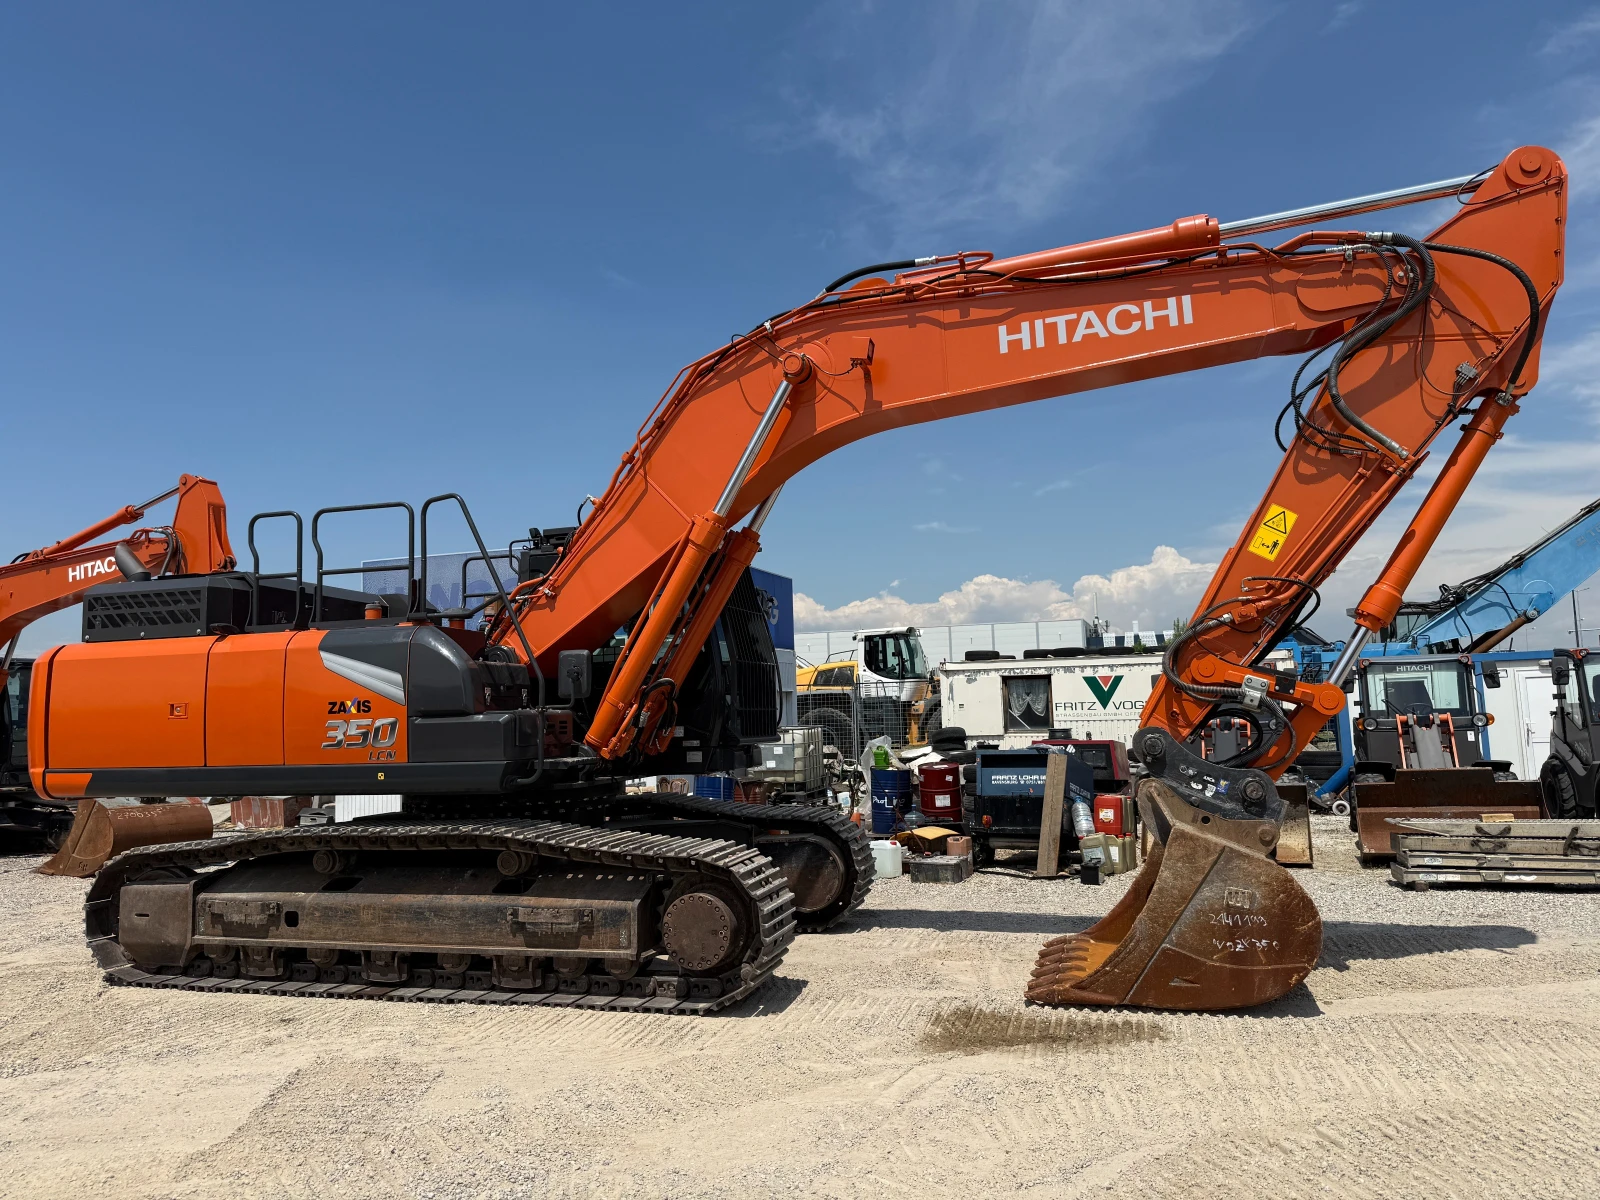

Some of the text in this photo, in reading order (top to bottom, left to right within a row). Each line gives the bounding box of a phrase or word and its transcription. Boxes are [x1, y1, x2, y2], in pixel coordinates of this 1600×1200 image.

[998, 294, 1193, 354] HITACHI
[68, 556, 119, 582] HITAC
[1396, 664, 1434, 672] HITACHI
[327, 697, 372, 714] ZAXIS
[1055, 700, 1148, 711] FRITZ VOG
[321, 717, 399, 749] 350
[368, 749, 396, 761] LCN
